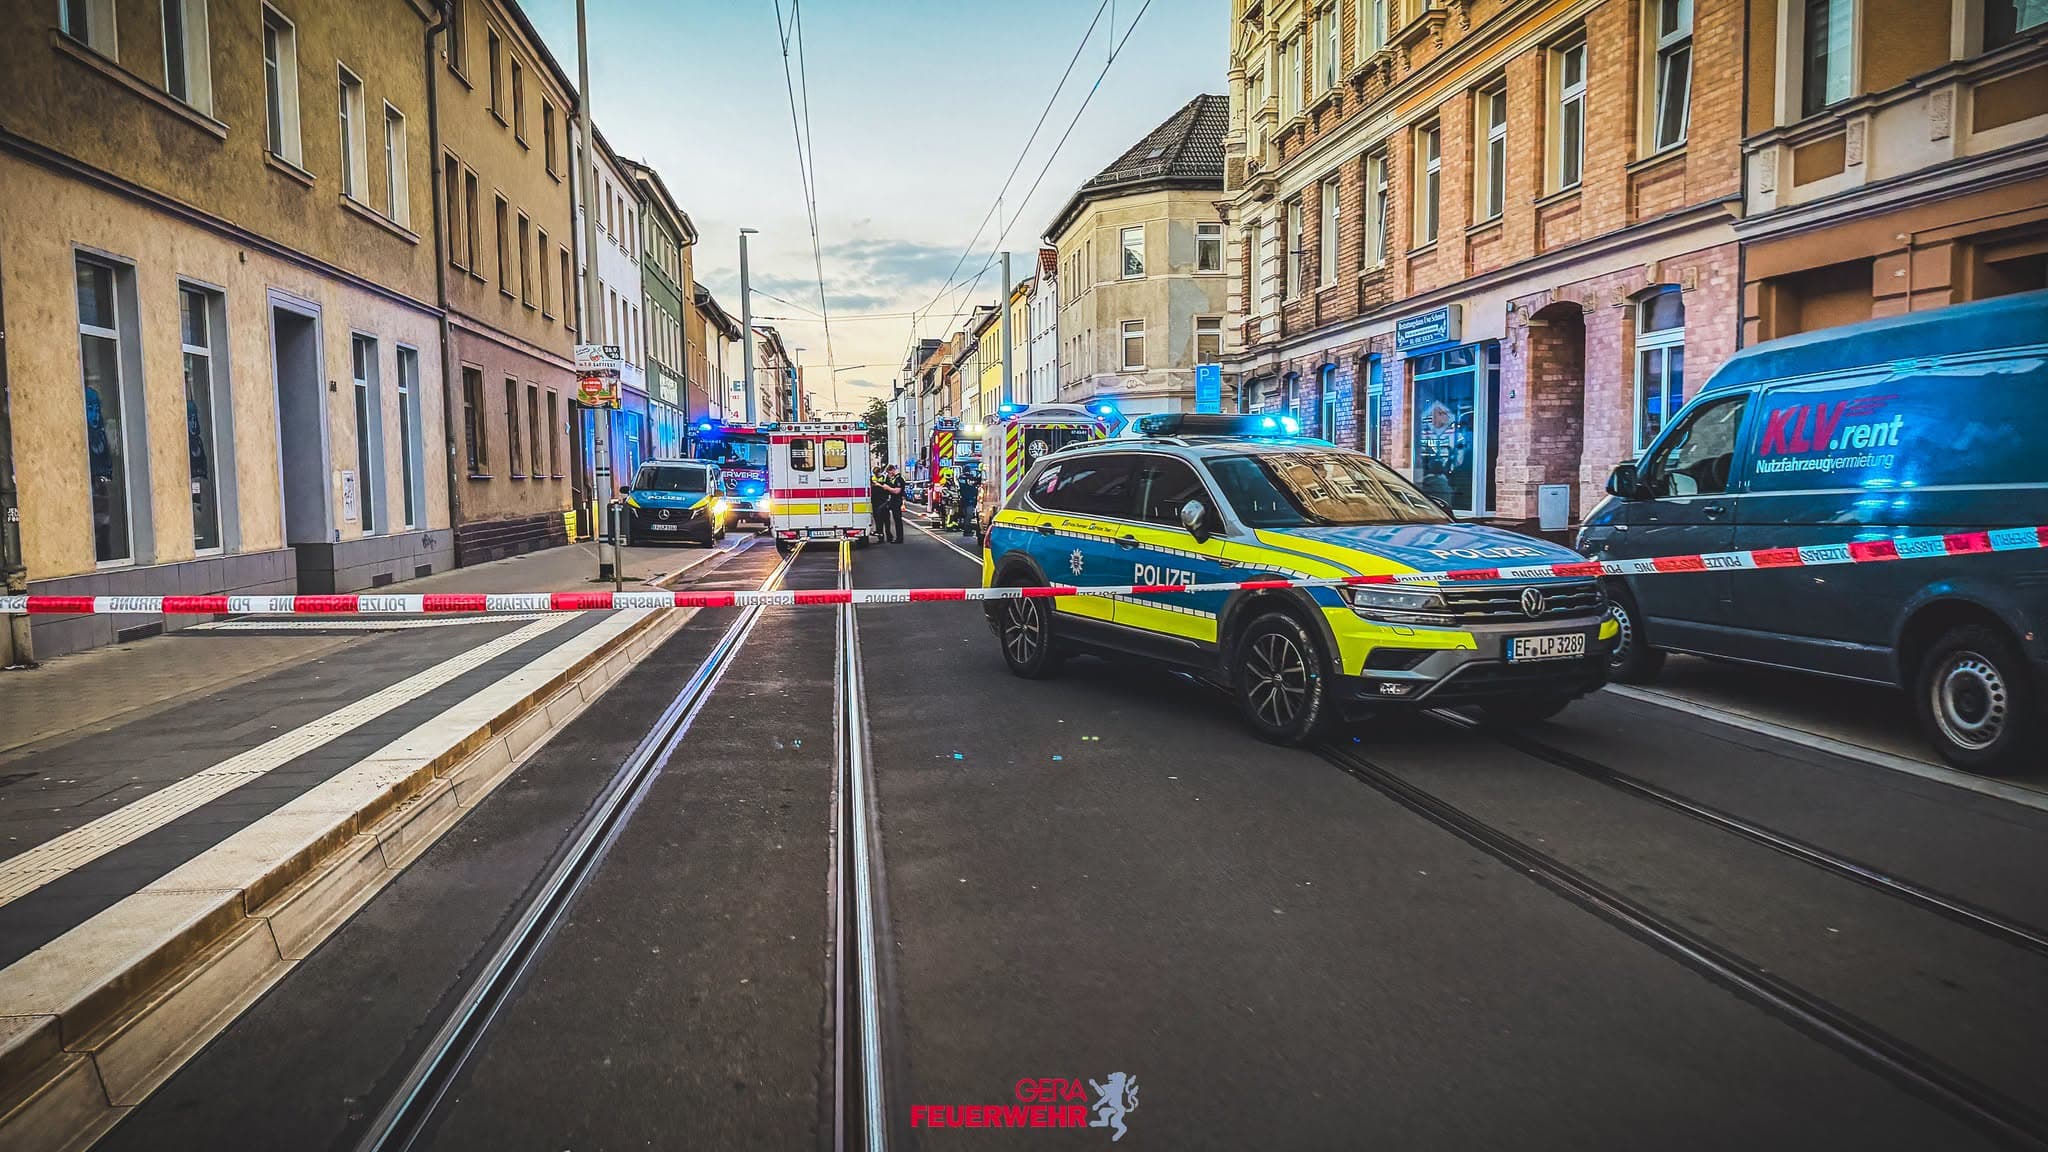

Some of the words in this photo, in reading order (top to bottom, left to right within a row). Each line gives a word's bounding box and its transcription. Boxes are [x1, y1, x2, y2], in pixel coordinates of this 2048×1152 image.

[1756, 452, 1894, 474] Nutzfahrzeugvermietung
[722, 471, 759, 480] ERWEHR
[1429, 546, 1548, 560] POLIZEI
[1134, 563, 1196, 588] POLIZEI
[1515, 639, 1531, 657] EF
[1540, 638, 1554, 655] LP
[1557, 635, 1584, 653] 3289
